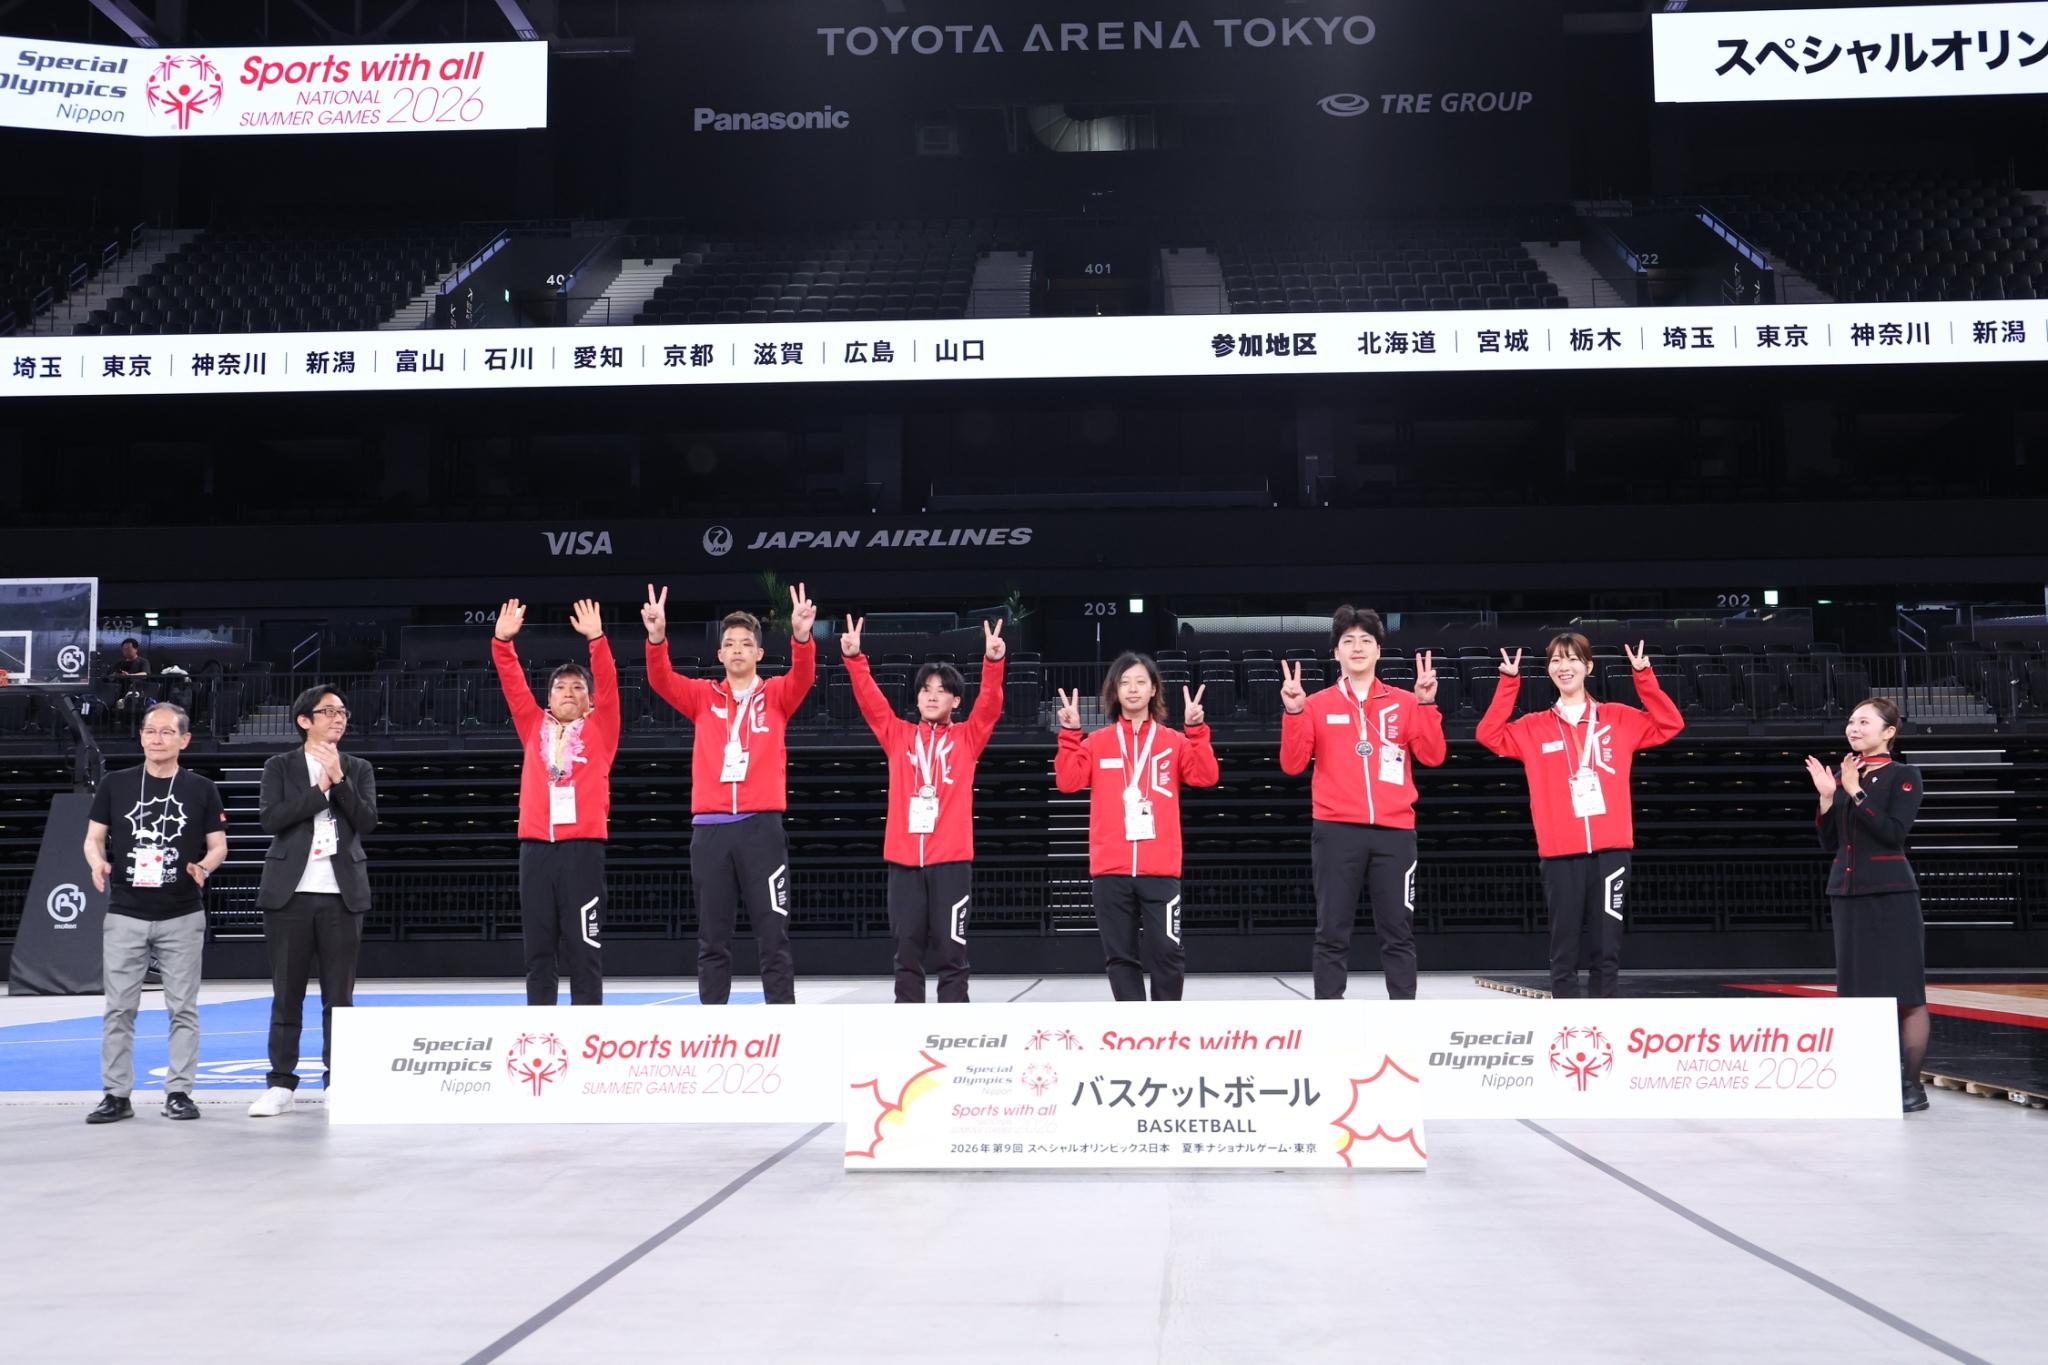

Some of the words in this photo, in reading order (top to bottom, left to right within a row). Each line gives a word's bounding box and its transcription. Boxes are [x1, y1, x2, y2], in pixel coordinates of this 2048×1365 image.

[817, 25, 1003, 56] TOYOTA
[1023, 20, 1200, 52] ARENA
[1214, 15, 1376, 48] TOKYO
[17, 50, 128, 74] Special
[1715, 29, 2048, 77] スペシャルオリン
[240, 55, 350, 91] Sports
[361, 52, 431, 82] with
[439, 51, 484, 80] all
[296, 90, 382, 105] NATIONAL
[386, 86, 484, 123] 2026
[1381, 94, 1432, 114] TRE
[1440, 91, 1533, 113] GROUP
[56, 103, 125, 124] Nippon
[239, 111, 313, 127] SUMMER
[318, 109, 381, 125] GAMES
[694, 105, 850, 131] Panasonic
[1636, 253, 1659, 265] 22
[1084, 263, 1112, 275] 401
[546, 274, 574, 286] 40
[1211, 332, 1318, 358] 参加地区
[1357, 330, 1437, 355] 北海道
[1477, 329, 1530, 353] 宮城
[1569, 328, 1622, 352] 栃木
[1662, 326, 1715, 350] 埼玉
[1756, 324, 1809, 348] 東京
[1850, 322, 1931, 347] 神奈川
[1972, 320, 2026, 344] 新潟
[13, 355, 62, 380] 埼玉
[102, 353, 152, 378] 東京
[191, 352, 267, 376] 神奈川
[306, 351, 356, 375] 新潟
[395, 349, 445, 373] 富山
[484, 347, 533, 371] 石川
[573, 346, 623, 369] 愛知
[663, 344, 714, 368] 京都
[753, 342, 803, 365] 滋賀
[844, 340, 894, 364] 広島
[935, 339, 985, 363] 山口
[541, 530, 613, 556] VISA
[747, 531, 861, 550] JAPAN
[865, 527, 1033, 548] AIRLINES
[1083, 602, 1117, 616] 203
[1716, 593, 1751, 608] 202
[464, 610, 496, 624] 204
[412, 1037, 493, 1055] Special
[582, 1034, 675, 1063] Sports
[680, 1034, 738, 1058] with
[745, 1034, 781, 1058] all
[926, 1034, 1008, 1050] Special
[1450, 1031, 1534, 1049] Special
[1627, 1028, 1721, 1059] Sports
[1729, 1028, 1790, 1053] with
[1797, 1028, 1834, 1053] all
[391, 1058, 493, 1075] Olympics
[966, 1065, 1013, 1075] Special
[1428, 1052, 1534, 1070] Olympics
[1676, 1059, 1750, 1073] NATIONAL
[629, 1065, 697, 1078] NATIONAL
[702, 1063, 783, 1095] 2026
[953, 1075, 1013, 1086] Olympics
[1754, 1058, 1836, 1090] 2026
[440, 1078, 491, 1096] Nippon
[582, 1082, 643, 1096] SUMMER
[646, 1082, 697, 1096] GAMES
[1481, 1073, 1534, 1090] Nippon
[1629, 1076, 1692, 1090] SUMMER
[1696, 1076, 1749, 1090] GAMES
[1072, 1075, 1320, 1109] バスケットボール
[952, 1104, 999, 1118] Sports
[1004, 1104, 1034, 1116] with
[1037, 1104, 1057, 1116] all
[1137, 1119, 1257, 1133] BASKETBALL
